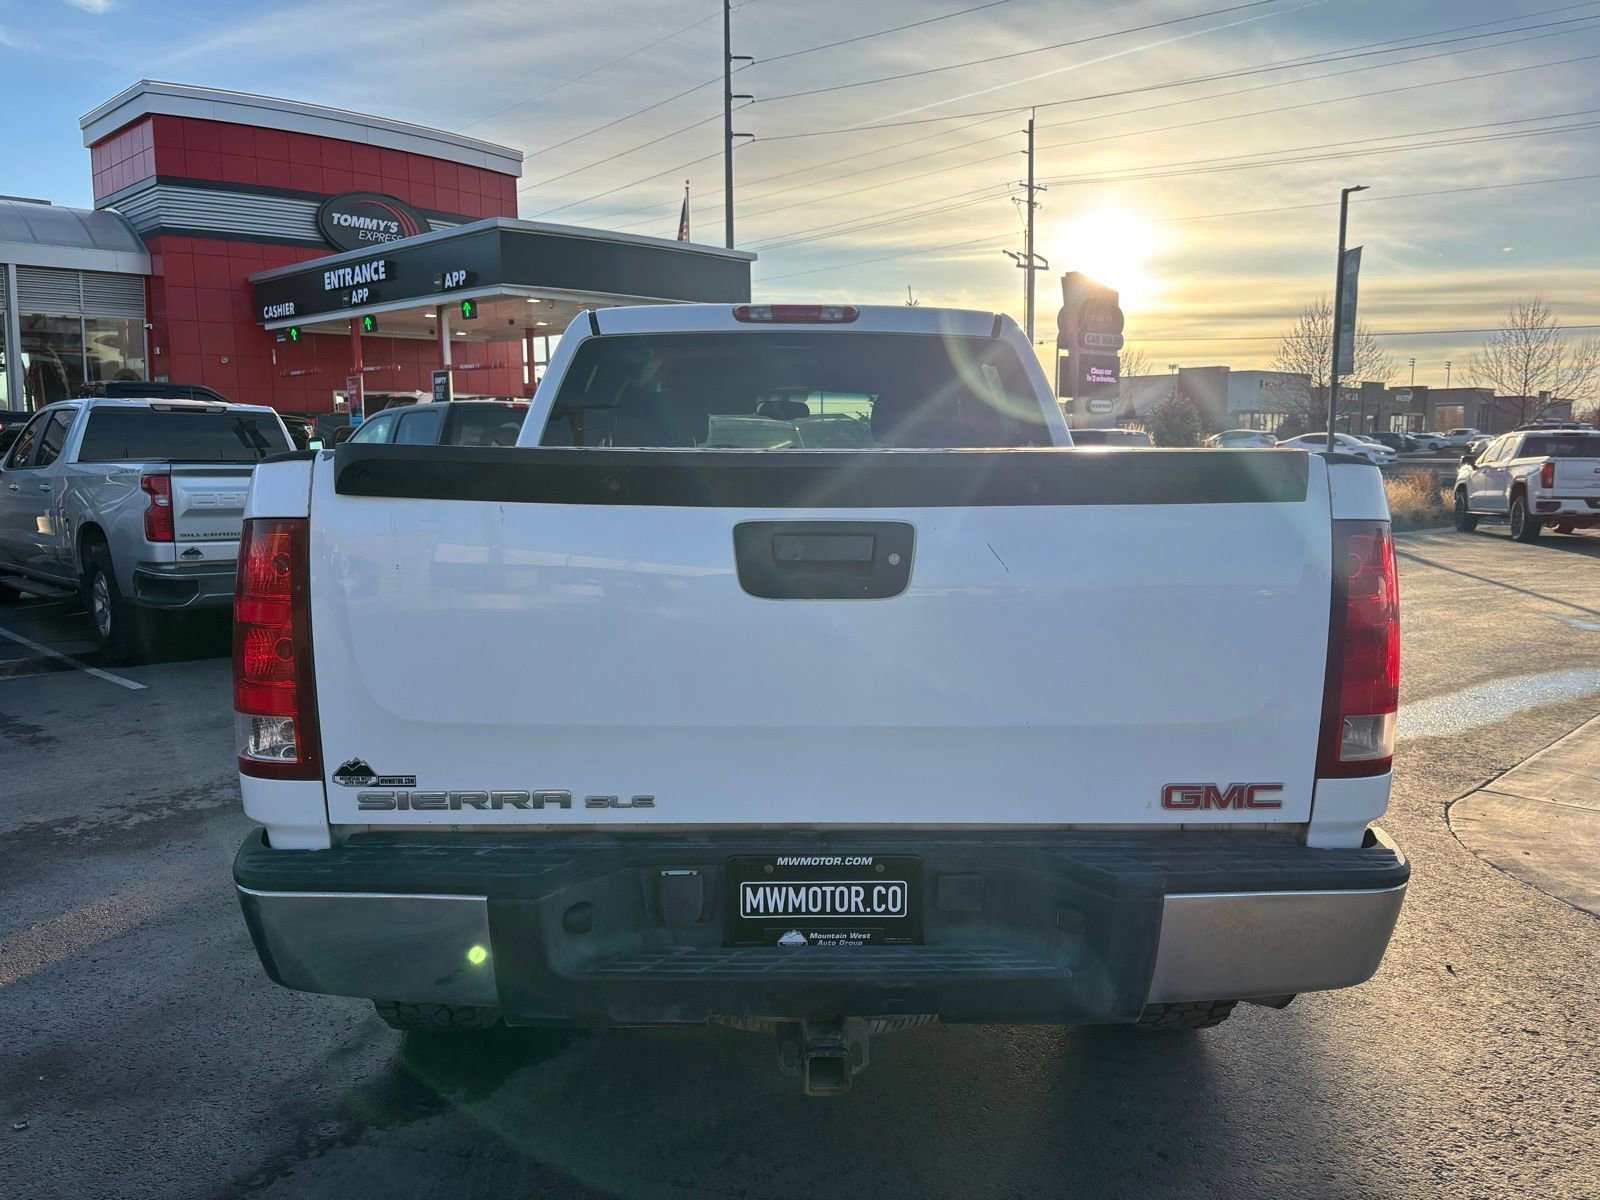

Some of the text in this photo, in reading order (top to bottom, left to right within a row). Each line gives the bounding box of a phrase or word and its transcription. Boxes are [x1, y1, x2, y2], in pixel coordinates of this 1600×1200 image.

[332, 213, 400, 233] TOMMY'S
[324, 260, 386, 290] ENTRANCE
[445, 270, 466, 288] APP
[351, 288, 369, 304] APP
[263, 302, 295, 319] CASHIER
[357, 789, 655, 810] SIERRA SLE
[1162, 783, 1283, 810] GMC
[777, 857, 873, 866] MWMOTOR.COM
[746, 886, 902, 913] MWMOTOR.CO
